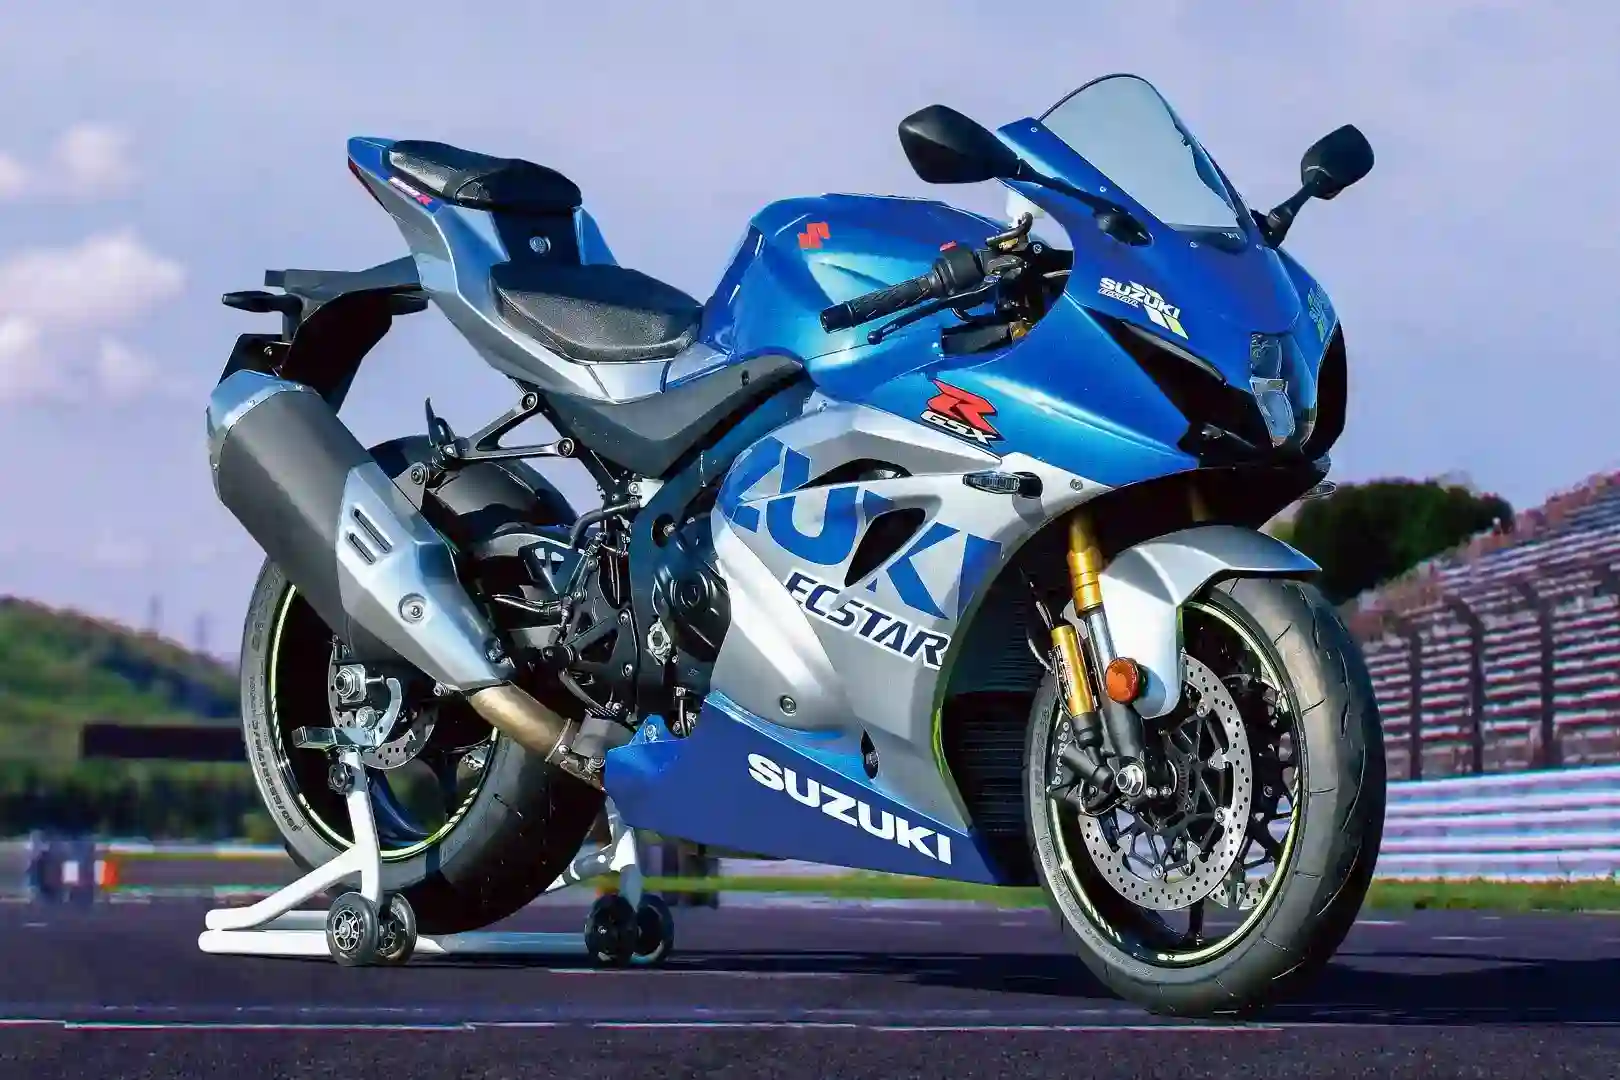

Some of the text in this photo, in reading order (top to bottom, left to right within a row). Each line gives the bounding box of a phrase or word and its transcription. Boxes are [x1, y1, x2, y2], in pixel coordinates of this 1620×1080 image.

[1099, 277, 1181, 320] SUZUKI
[920, 410, 997, 445] GSX
[785, 569, 951, 671] ECSTAR
[747, 753, 952, 865] SUZUKI
